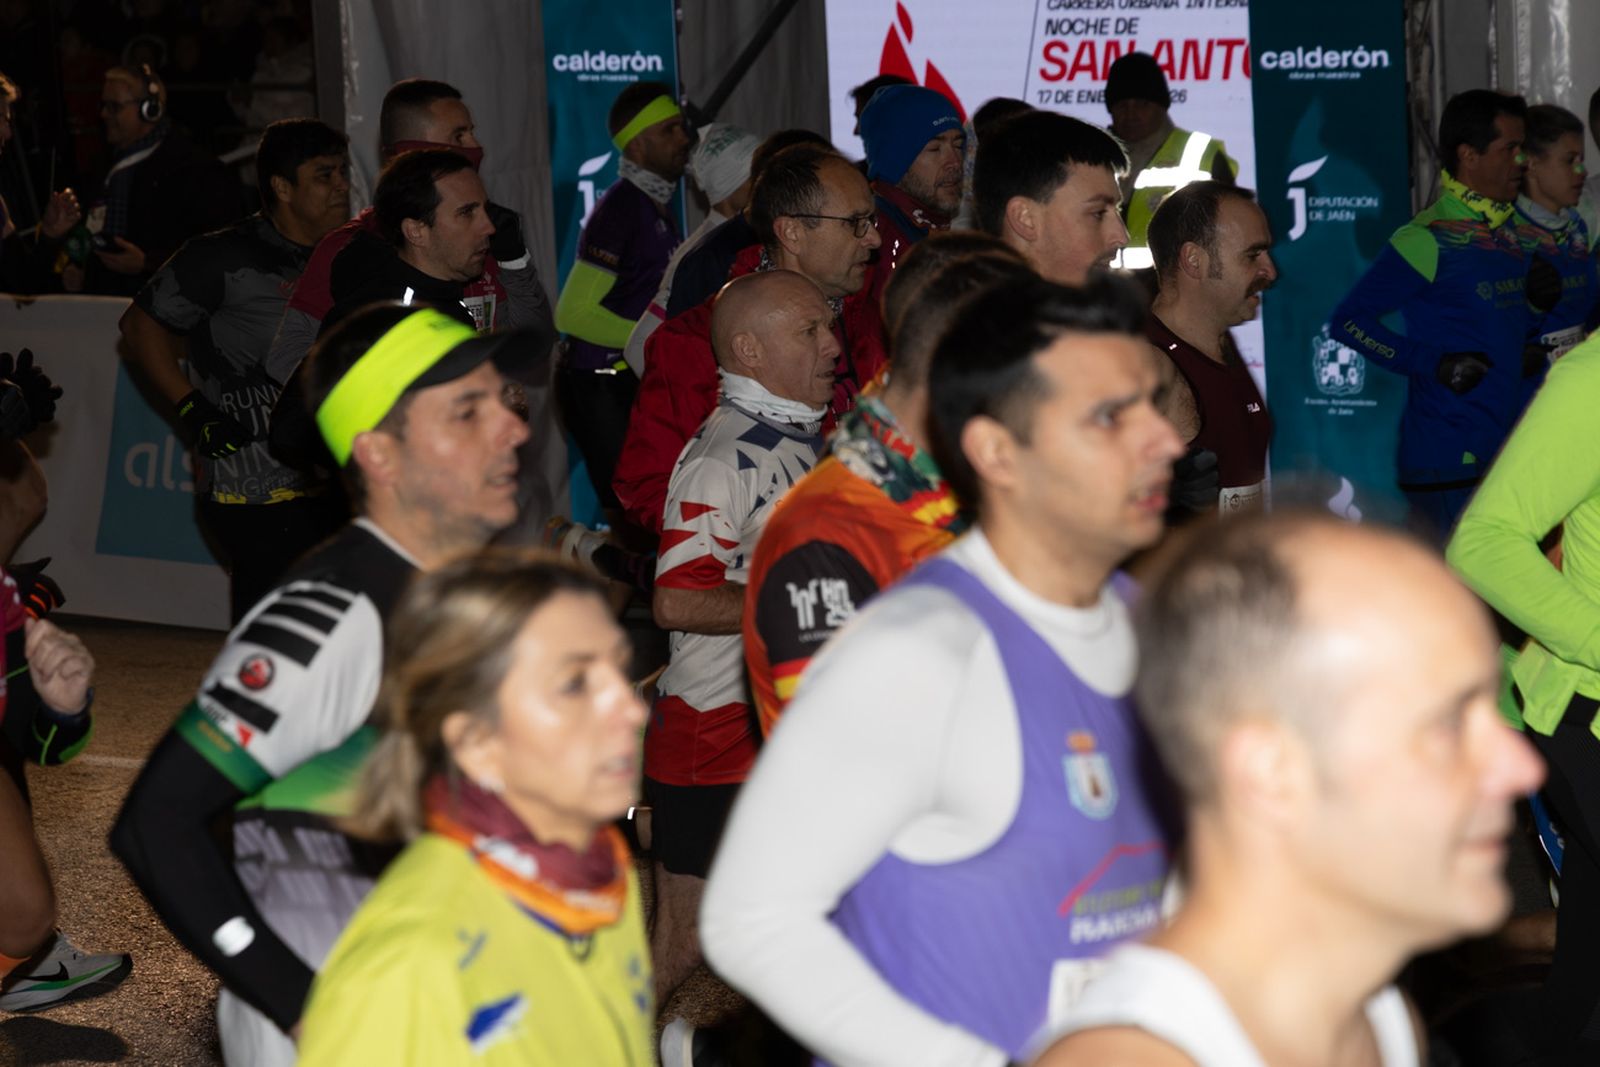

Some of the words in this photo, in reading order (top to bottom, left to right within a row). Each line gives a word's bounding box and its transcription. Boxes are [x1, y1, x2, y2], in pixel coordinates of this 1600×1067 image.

[1047, 0, 1115, 10] CARRERA
[1118, 0, 1180, 10] URBANA
[1185, 0, 1249, 9] INTERN
[1045, 17, 1111, 36] NOCHE
[1114, 17, 1140, 35] DE
[552, 50, 664, 72] calderón
[1039, 39, 1136, 82] SAN
[1151, 38, 1251, 81] ANT
[1260, 45, 1389, 69] calderón
[1037, 89, 1052, 104] 17
[1054, 89, 1074, 104] DE
[1076, 89, 1107, 104] ENE
[1169, 88, 1188, 104] 26
[1308, 210, 1325, 221] DE
[222, 384, 282, 414] RUNN
[123, 434, 194, 492] als
